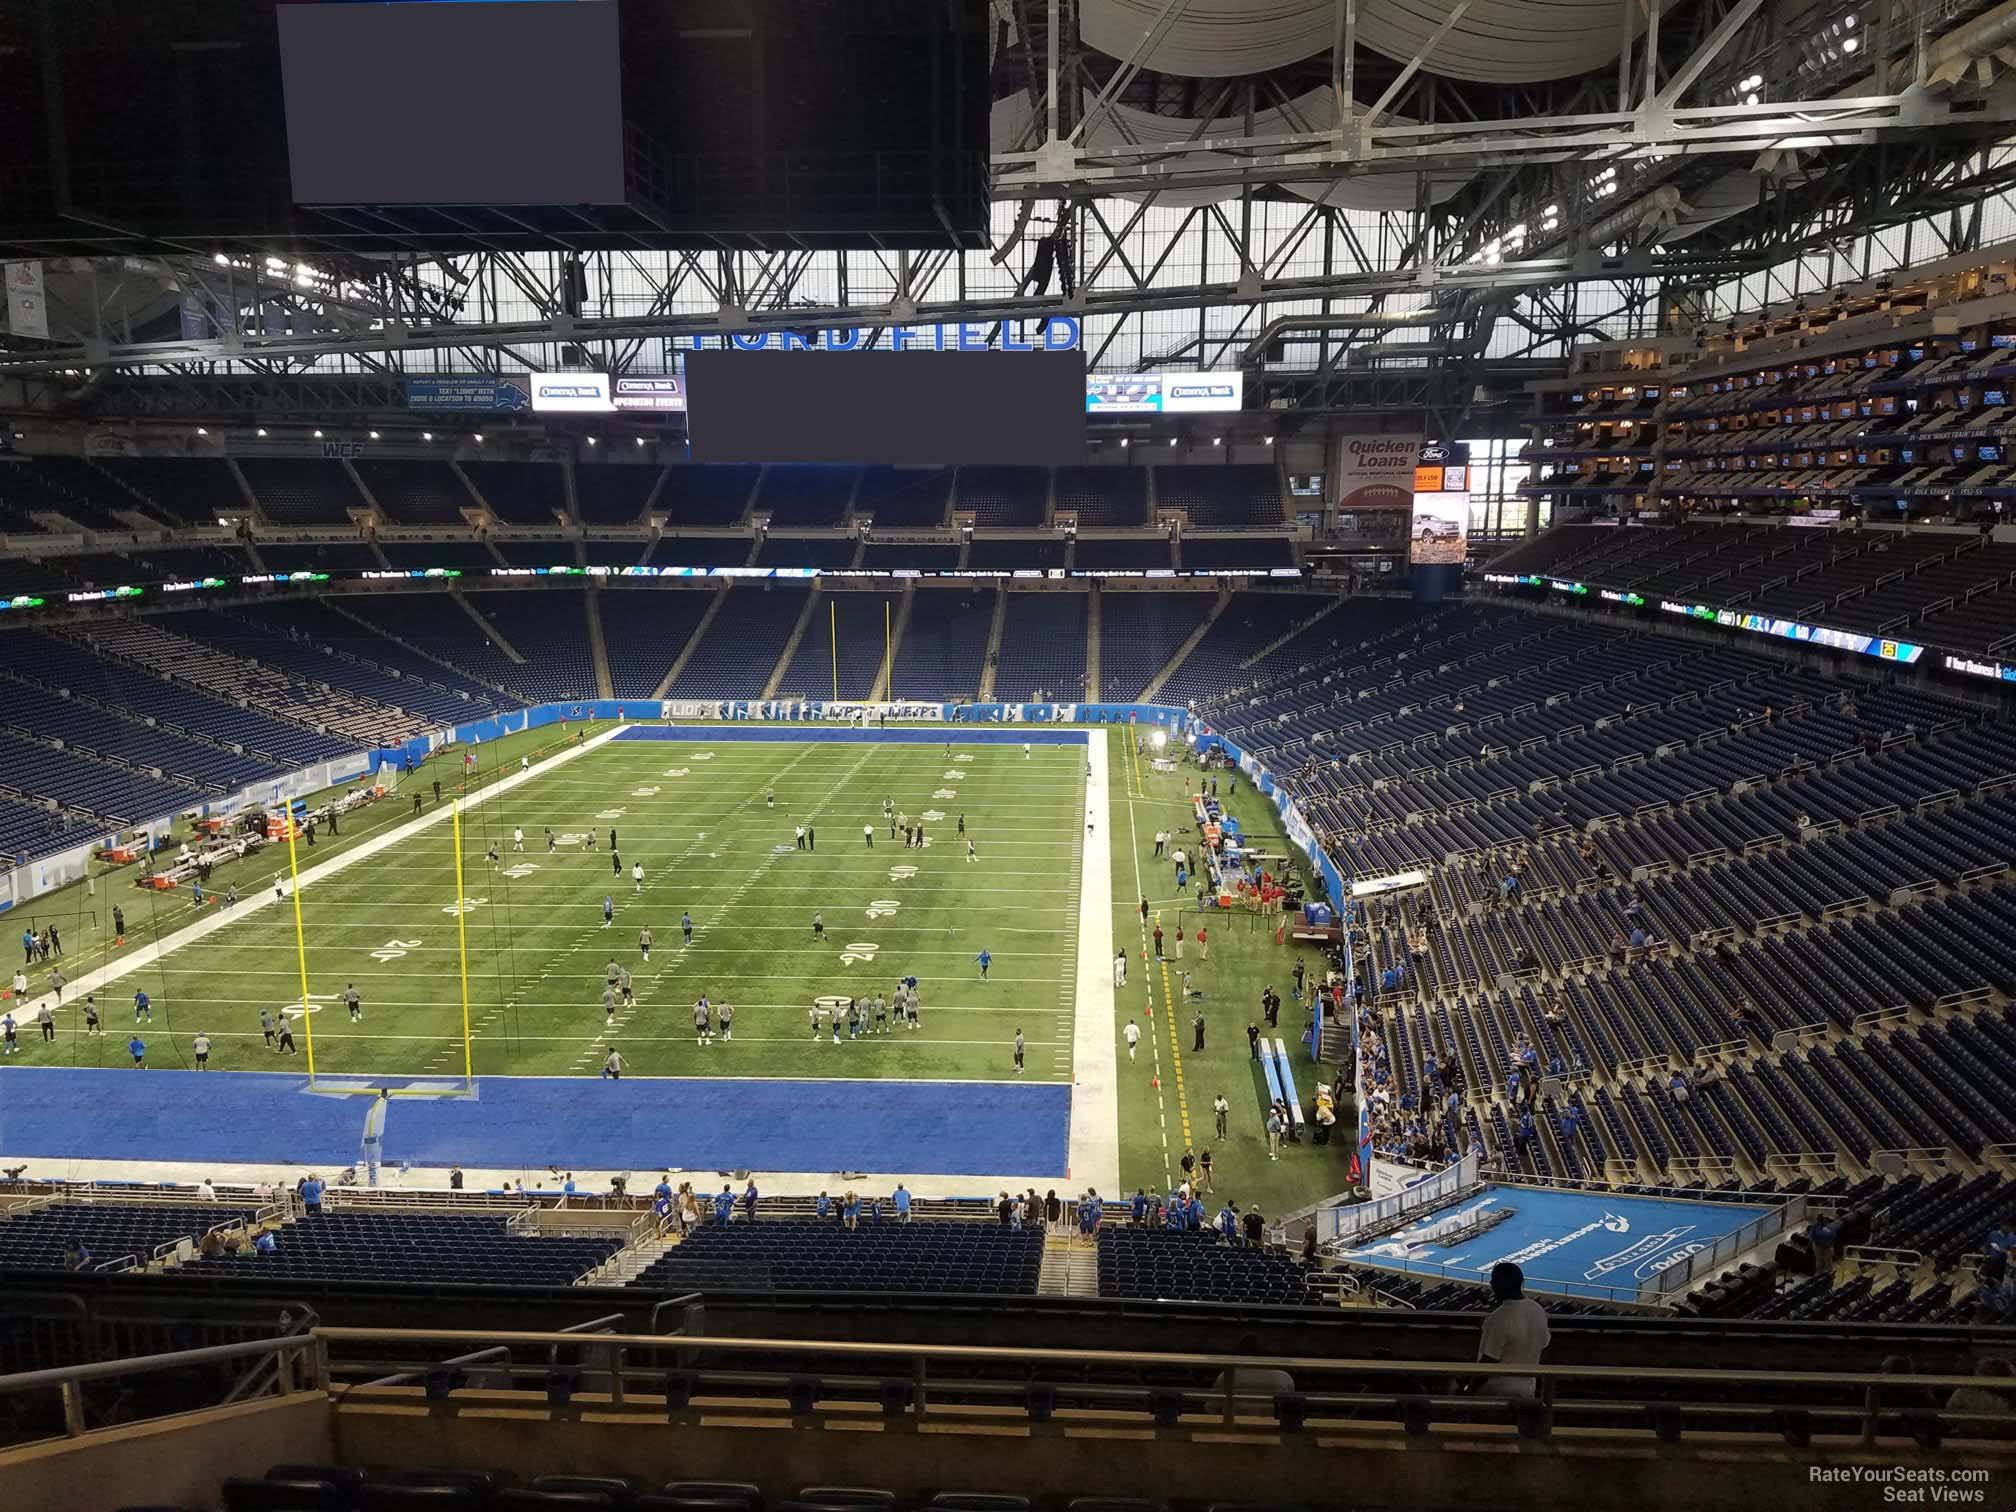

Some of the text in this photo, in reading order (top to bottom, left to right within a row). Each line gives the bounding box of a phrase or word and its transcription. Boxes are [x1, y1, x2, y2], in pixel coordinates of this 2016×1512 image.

[890, 315, 1080, 351] FIELD
[1349, 439, 1416, 455] Quicken
[1423, 446, 1444, 459] Ford
[1357, 454, 1408, 468] Loans
[1952, 656, 1966, 671] Your
[1966, 659, 1995, 677] Business
[888, 865, 919, 878] 40
[442, 897, 489, 913] 30
[865, 900, 902, 916] 30
[370, 940, 423, 958] 20
[840, 943, 880, 961] 20
[281, 993, 341, 1014] 10
